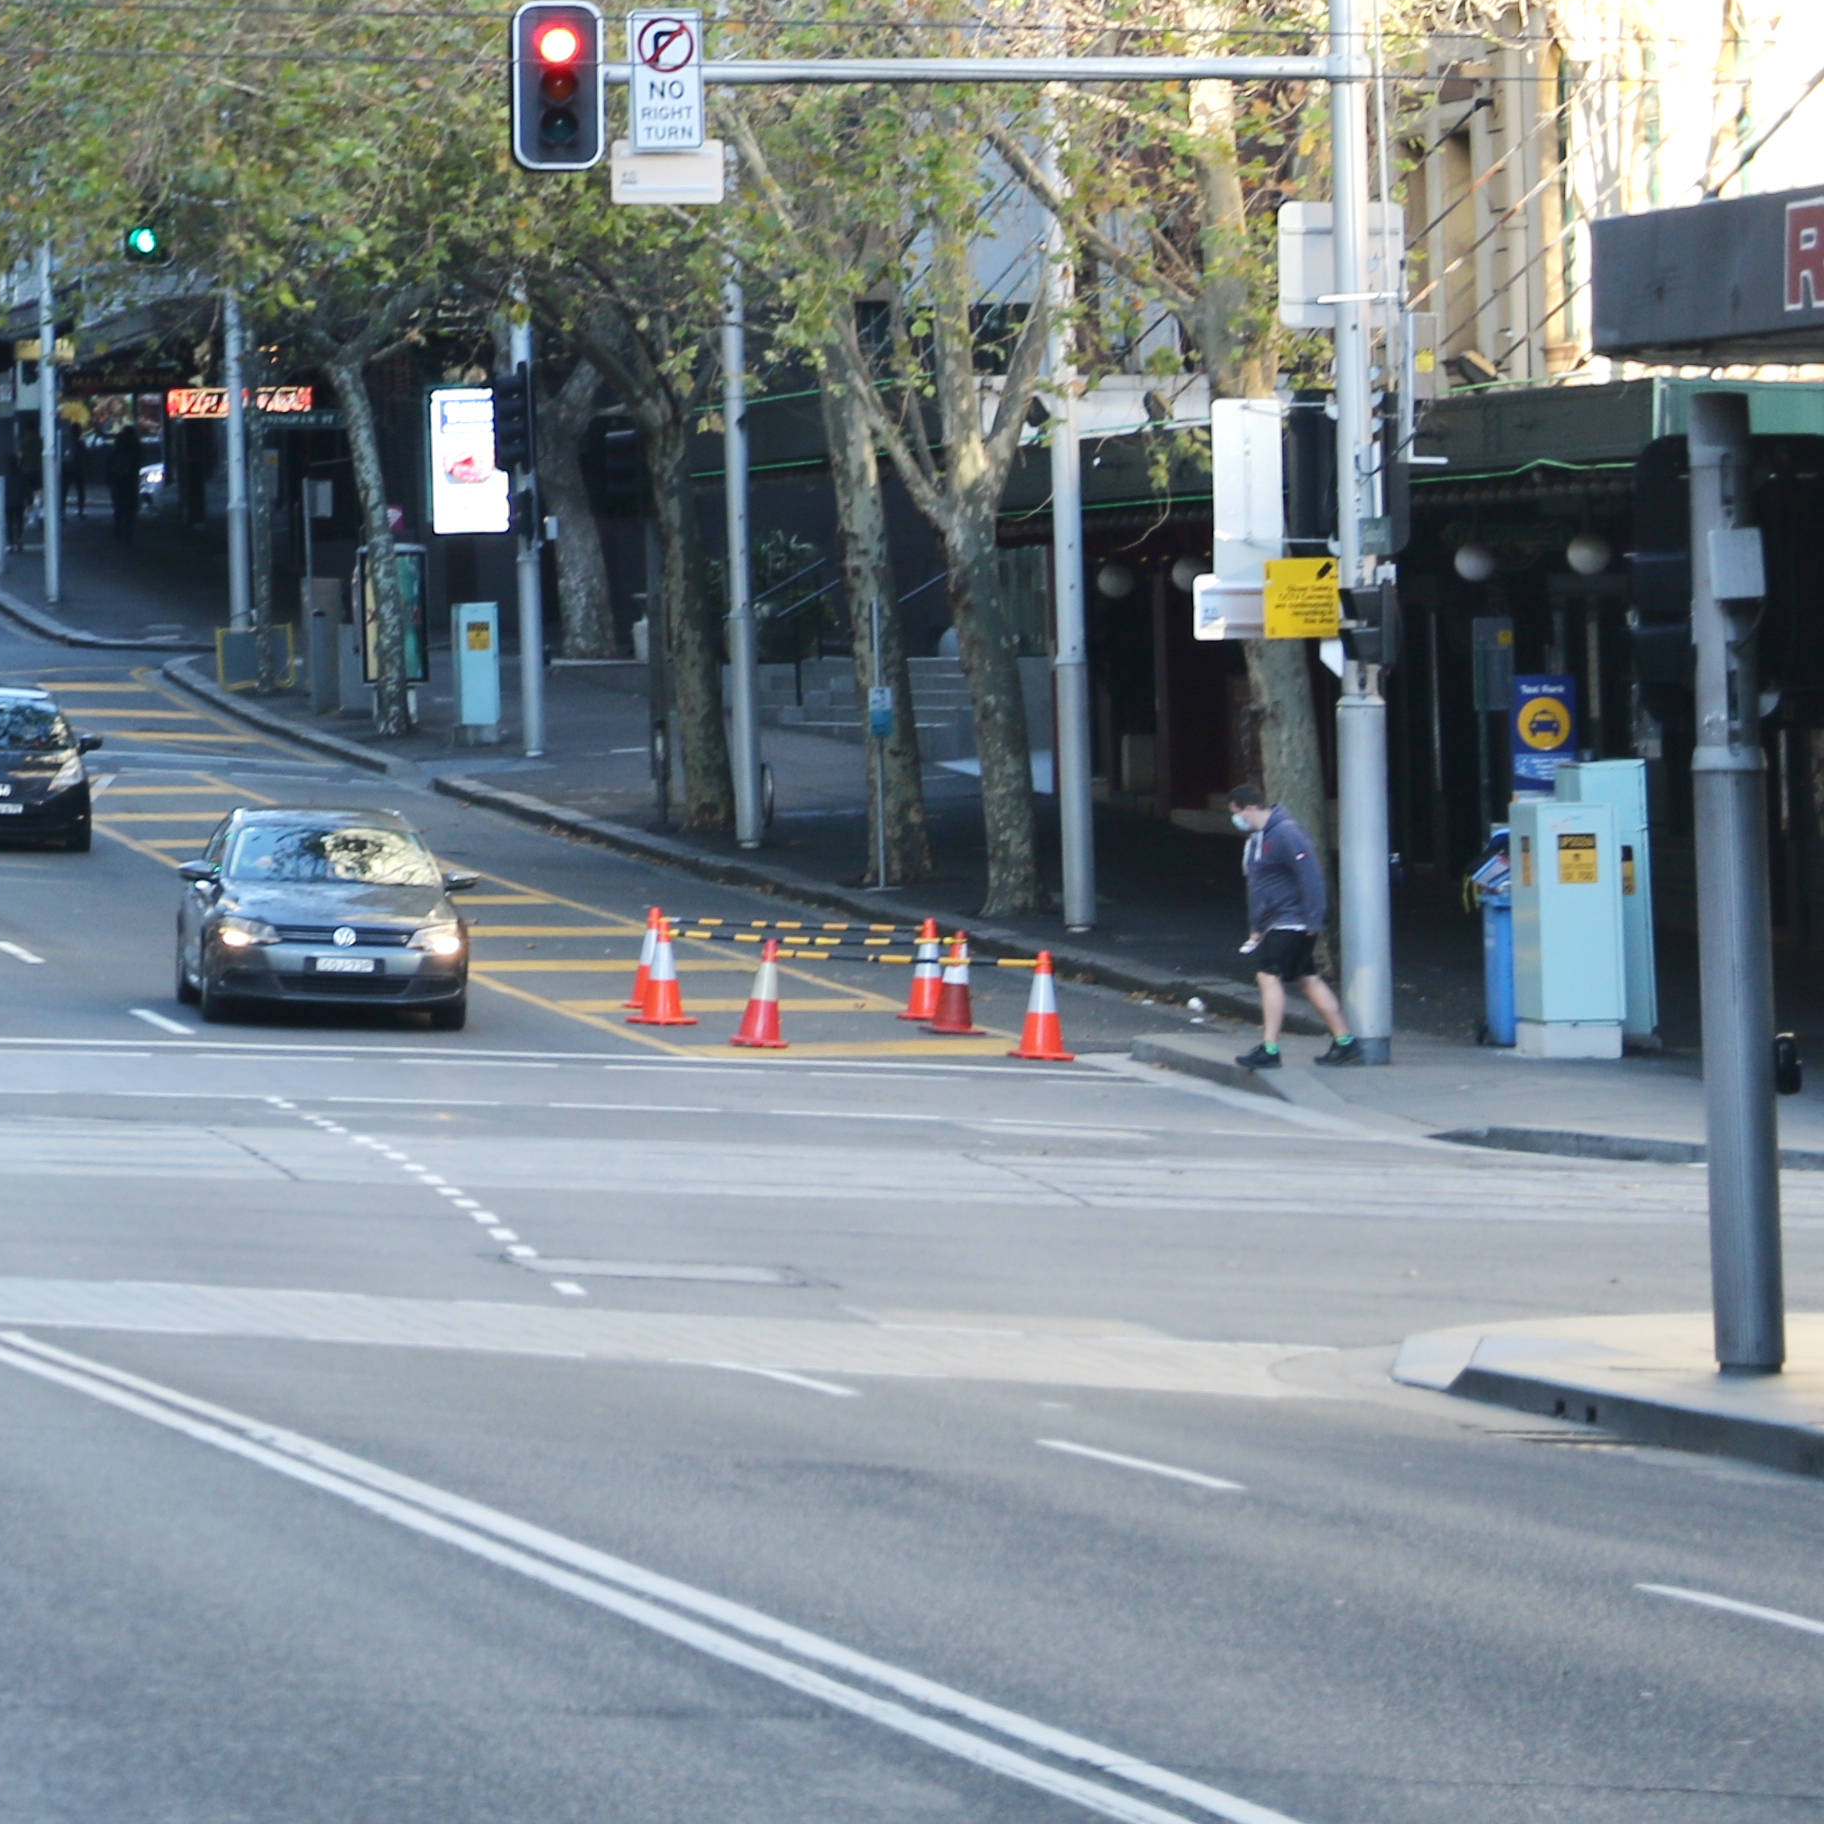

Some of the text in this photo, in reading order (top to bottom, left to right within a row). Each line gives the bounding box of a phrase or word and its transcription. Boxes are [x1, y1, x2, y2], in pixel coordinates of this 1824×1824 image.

[648, 80, 685, 100] NO
[640, 105, 695, 122] RIGHT
[643, 125, 693, 141] TURN
[1519, 683, 1566, 695] Taxi Rank
